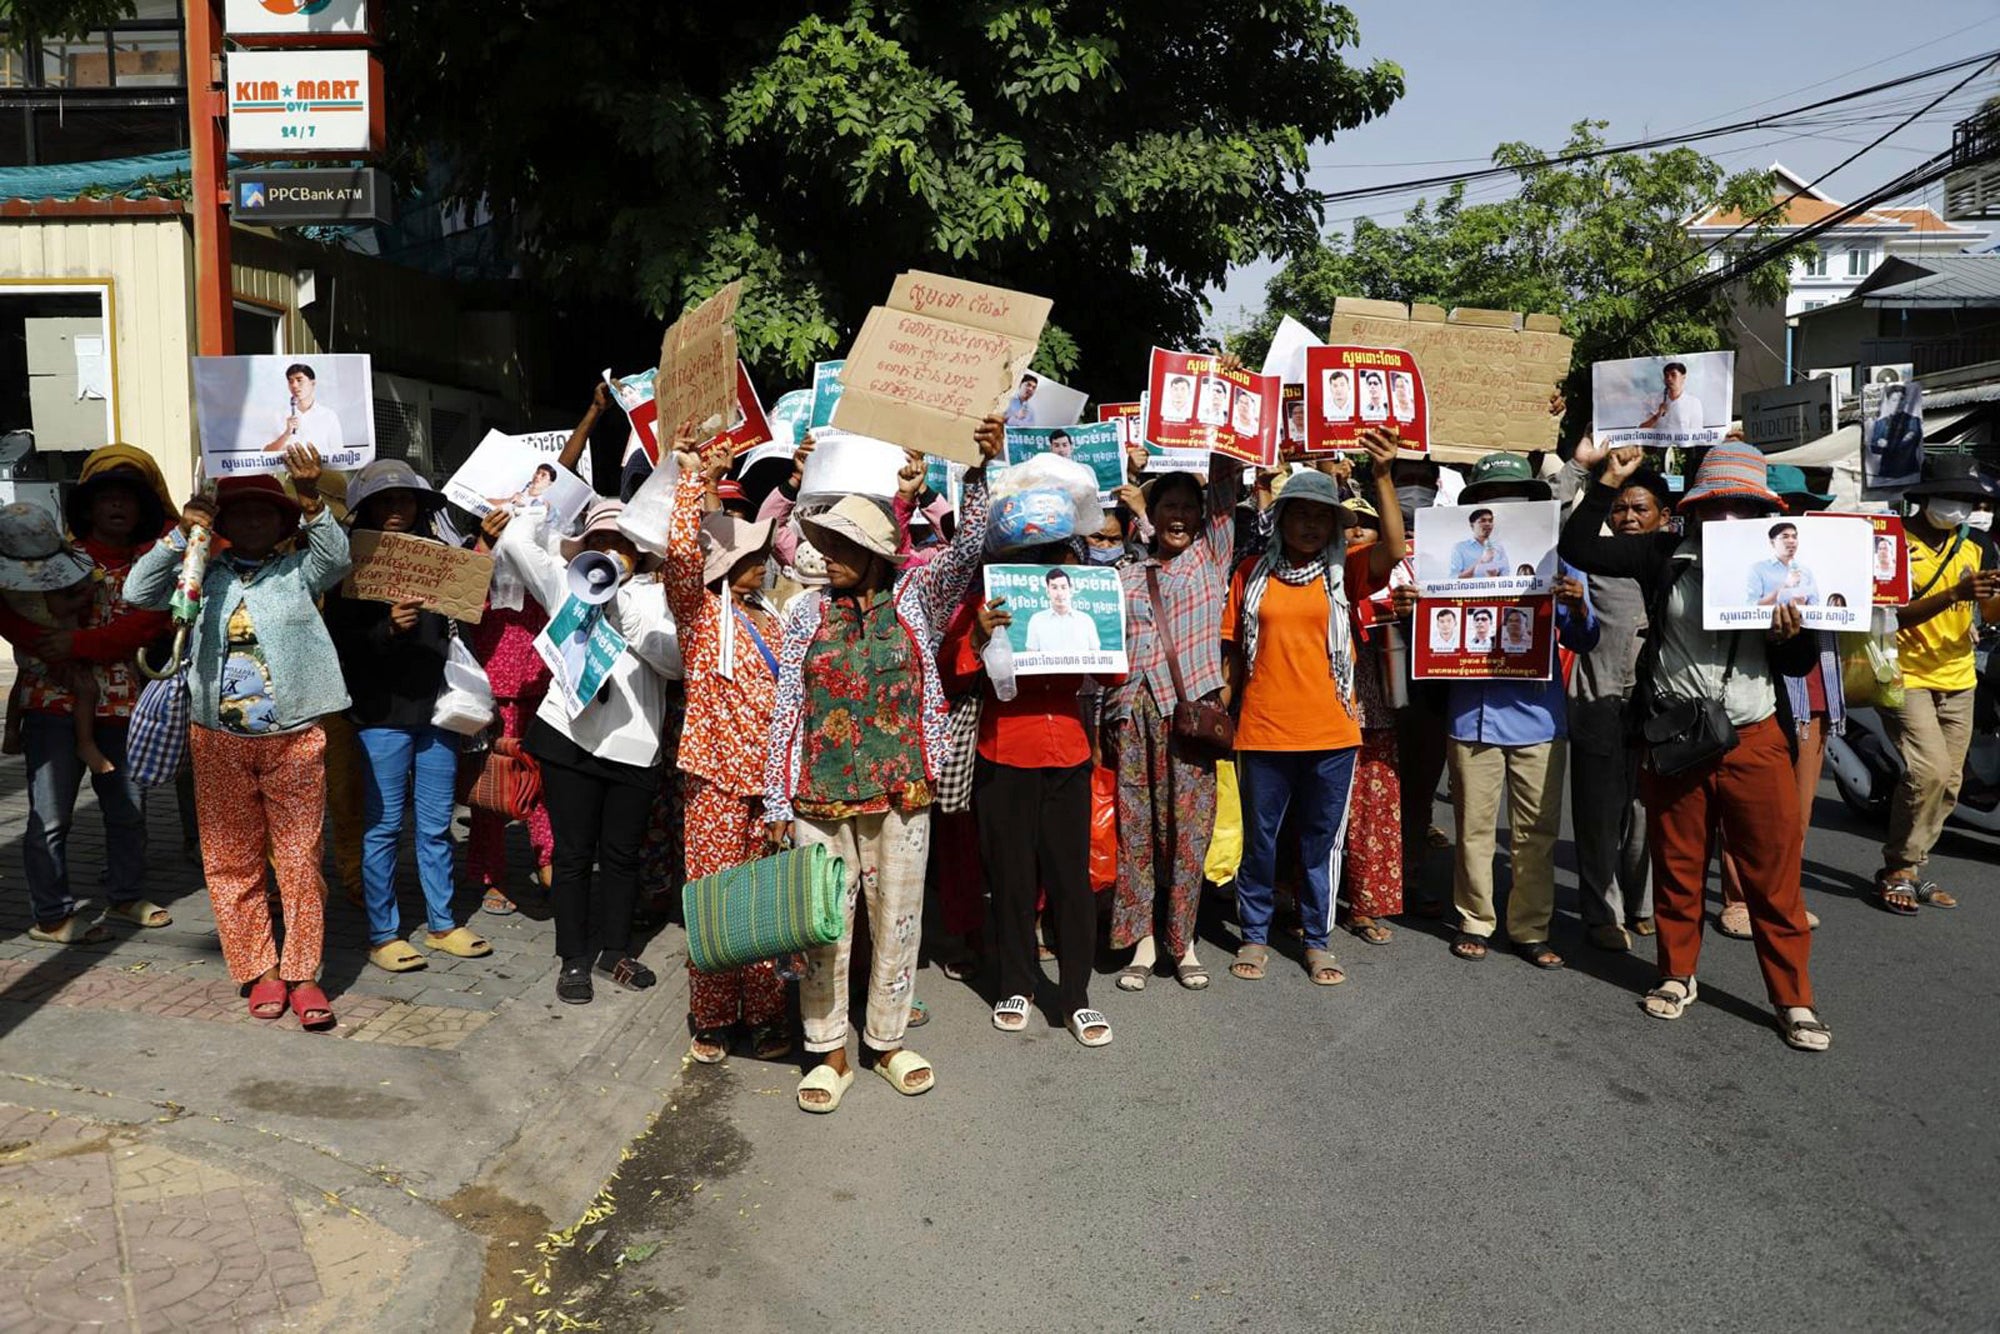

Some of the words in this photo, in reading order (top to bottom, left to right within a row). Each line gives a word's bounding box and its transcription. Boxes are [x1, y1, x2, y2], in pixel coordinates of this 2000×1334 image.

[235, 81, 279, 101] KIM
[297, 80, 360, 100] MART
[268, 187, 334, 201] PPCBank
[336, 188, 363, 200] ATM
